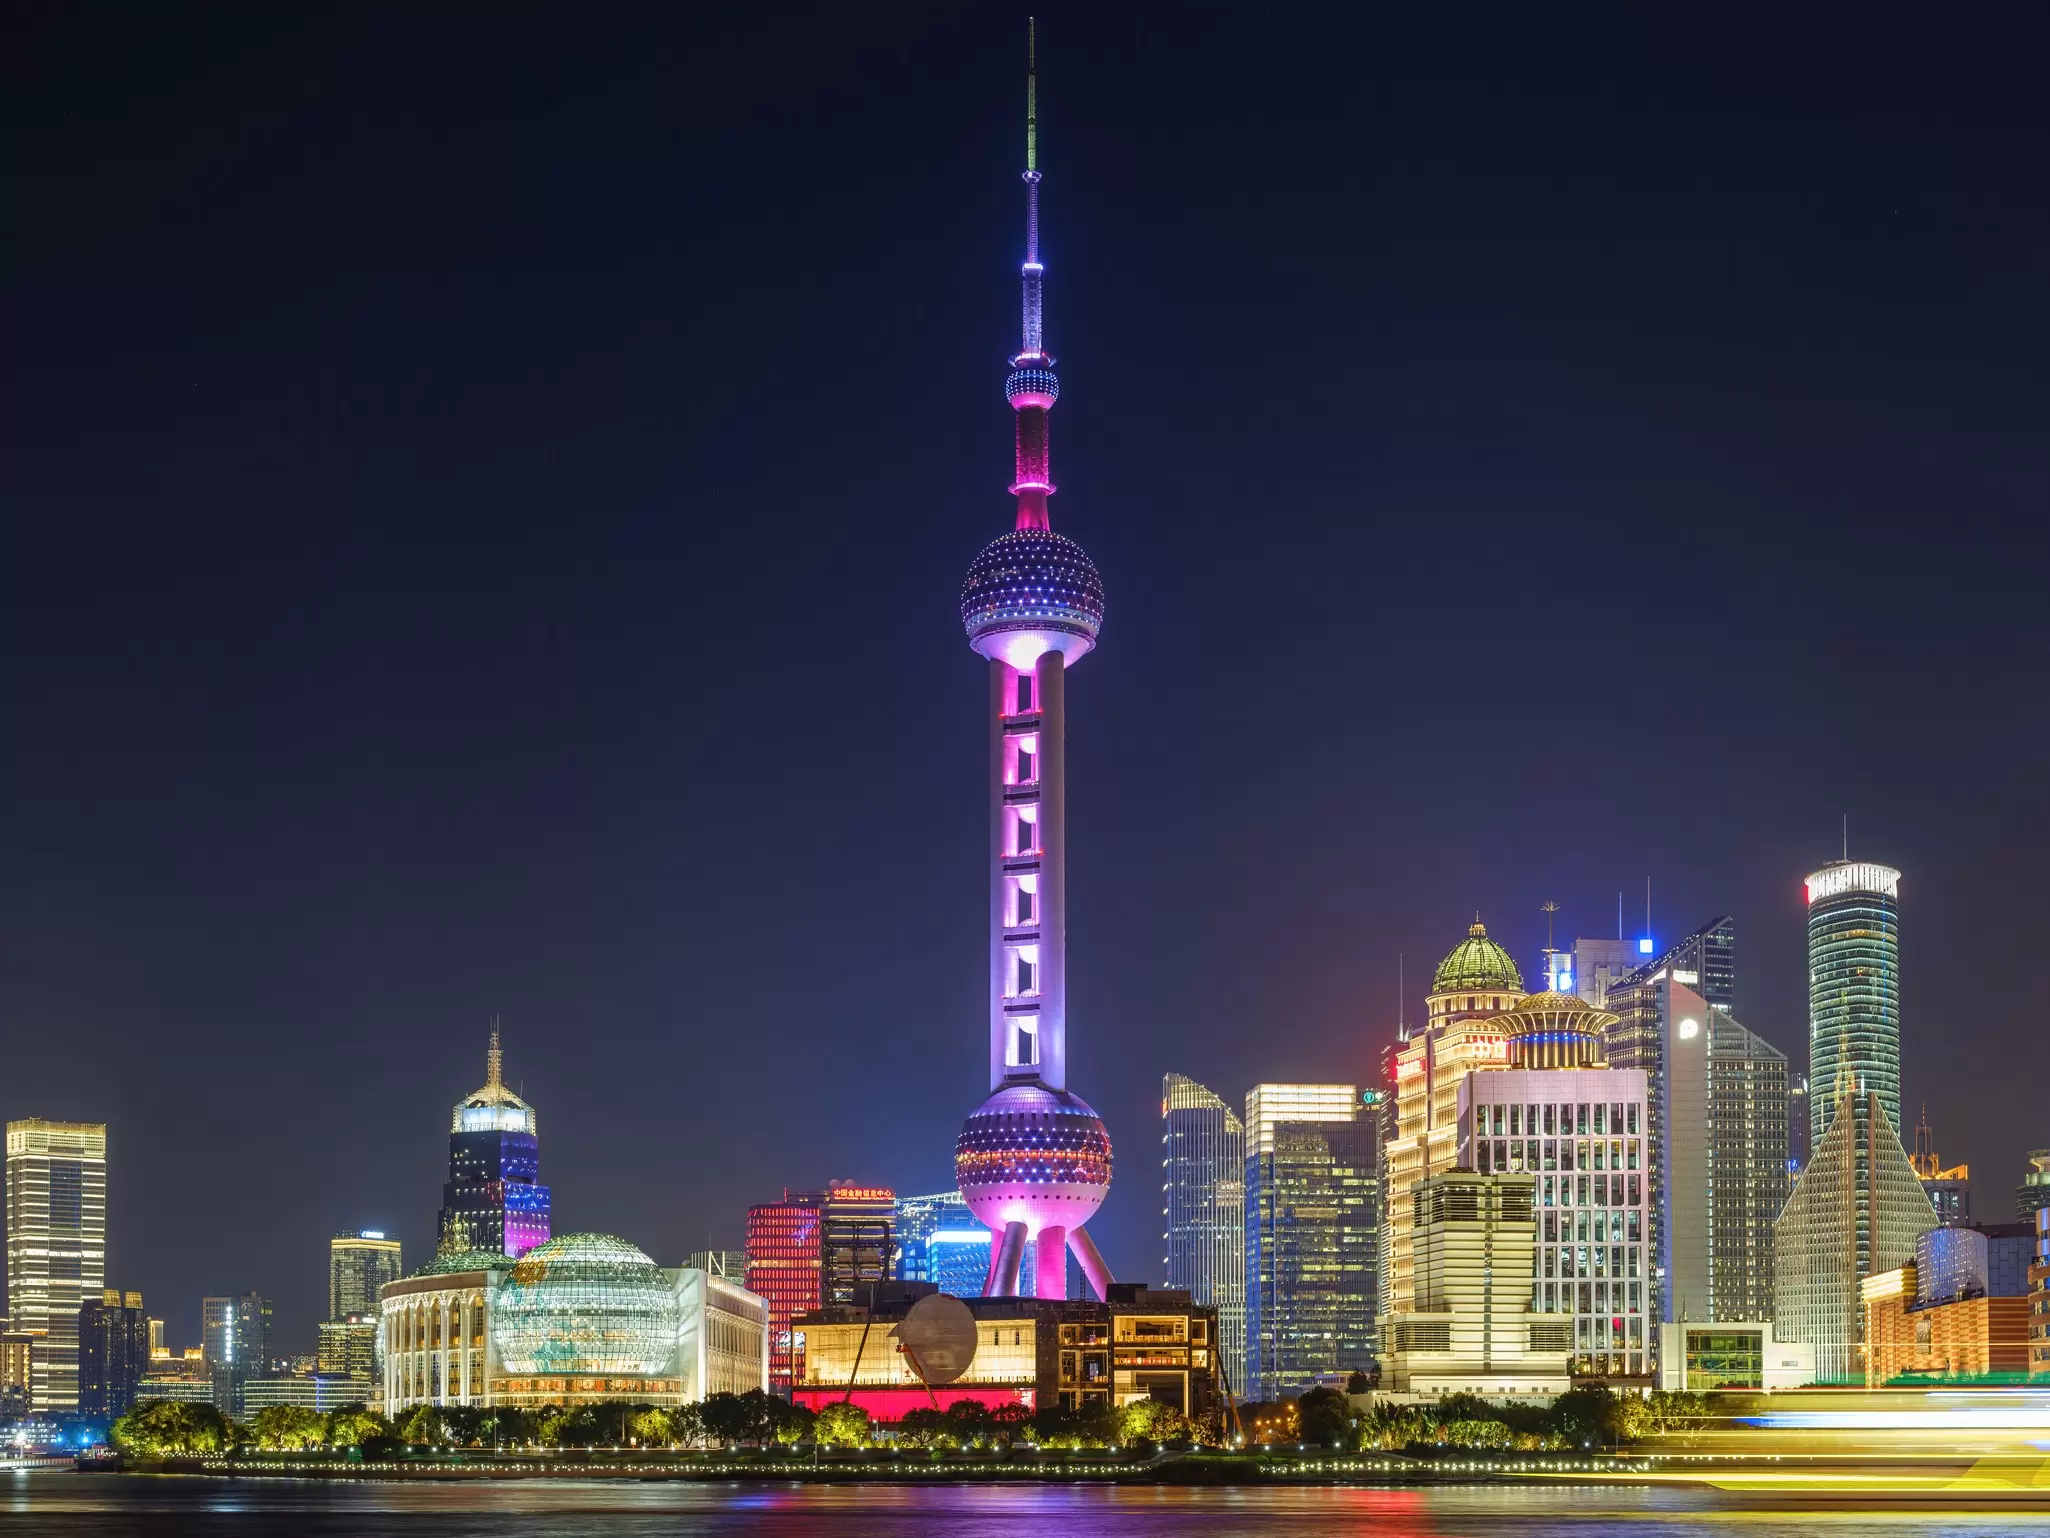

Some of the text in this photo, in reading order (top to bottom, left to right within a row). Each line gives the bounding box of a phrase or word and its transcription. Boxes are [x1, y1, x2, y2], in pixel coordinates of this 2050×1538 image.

[833, 1189, 892, 1197] 中国金融信息中心
